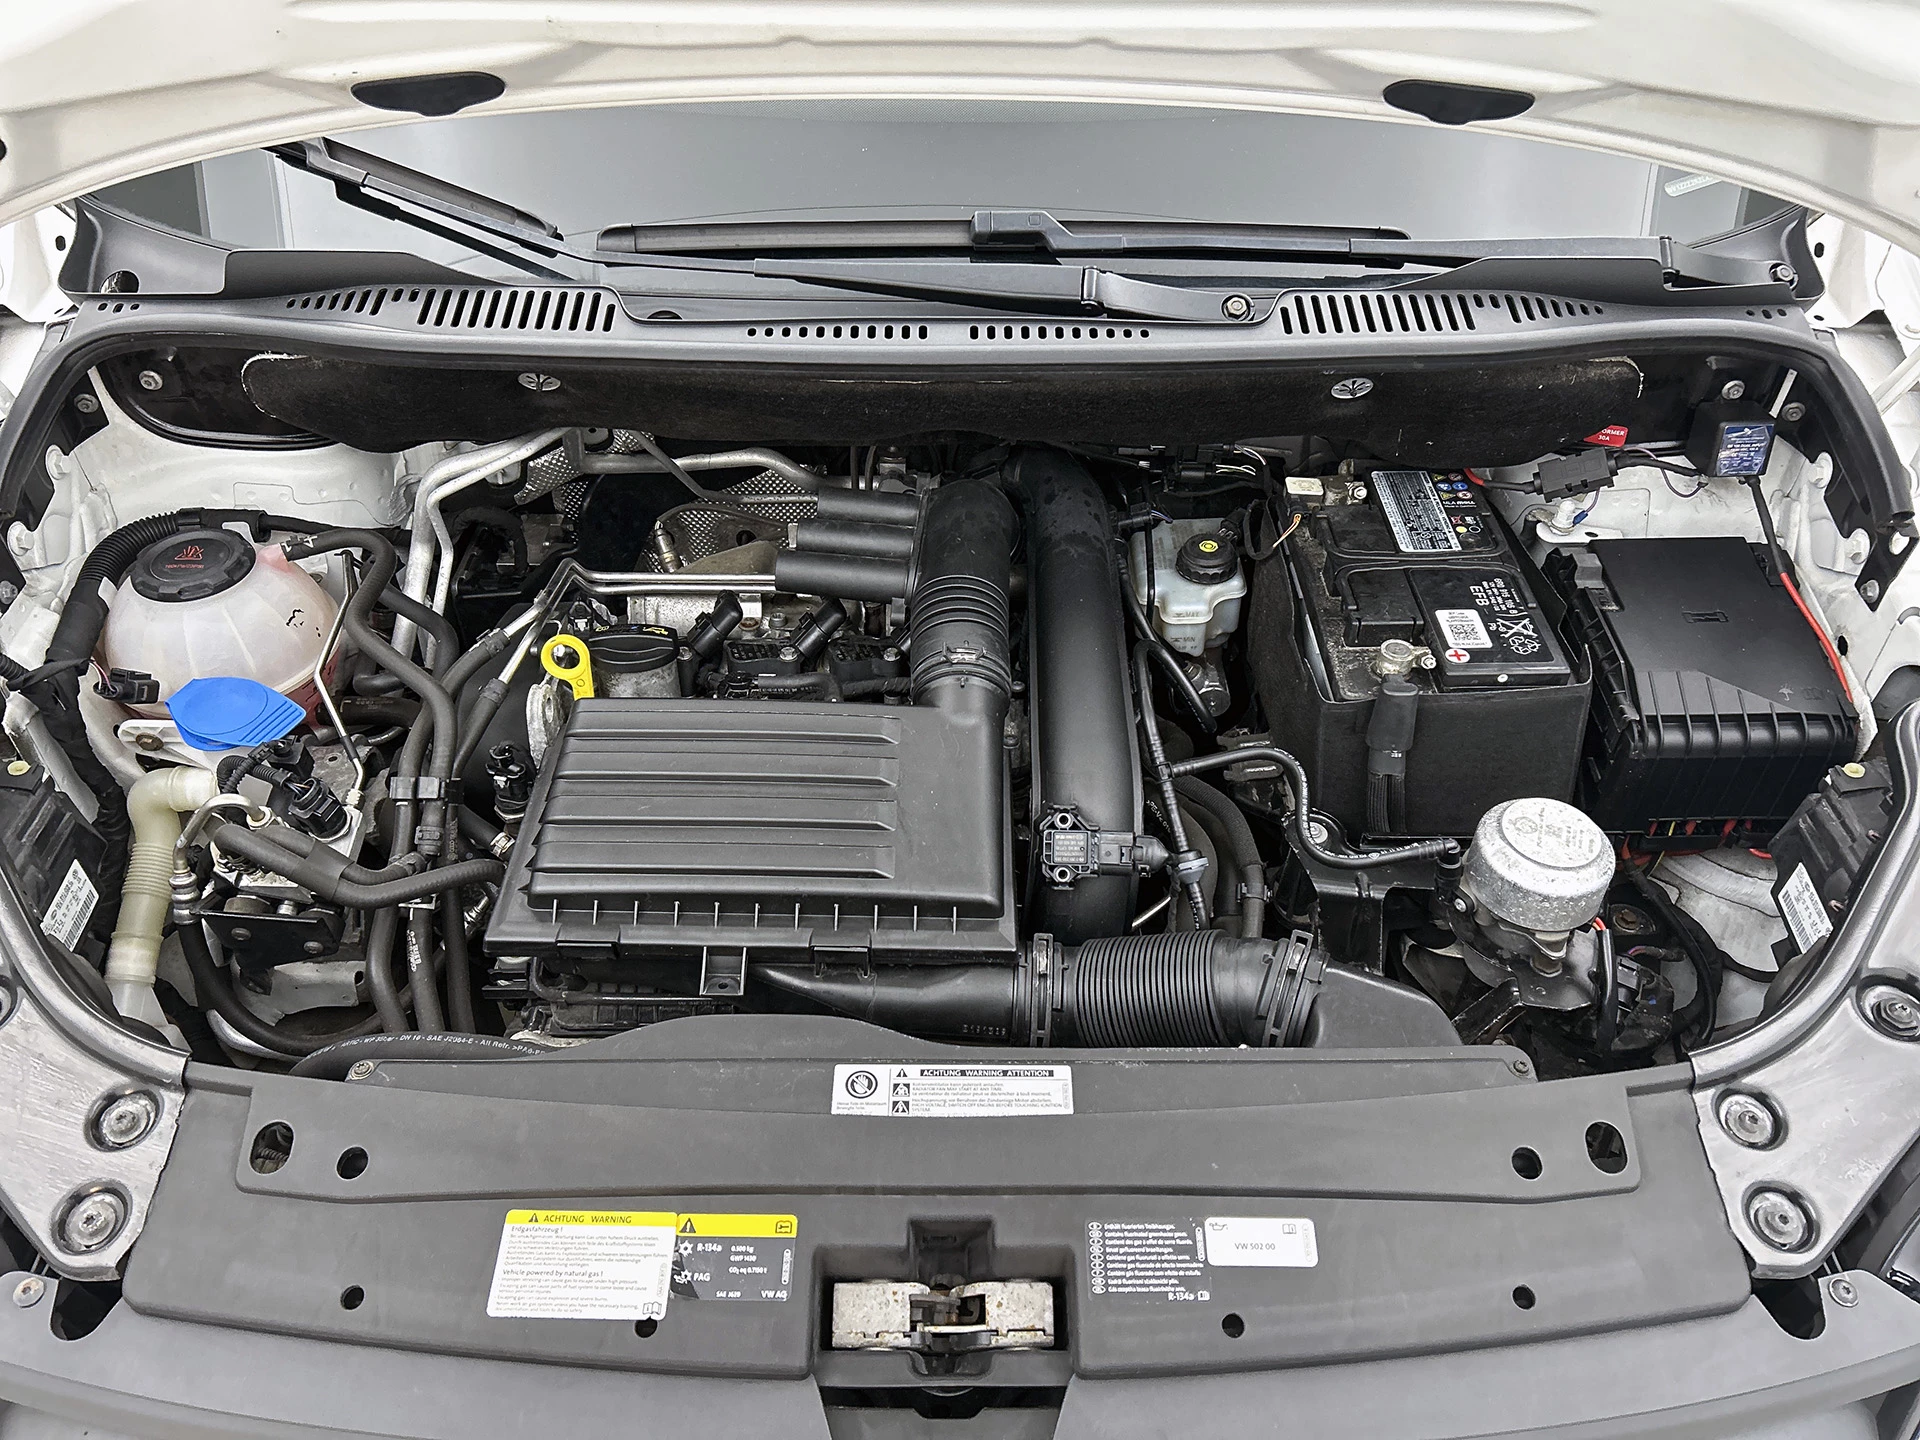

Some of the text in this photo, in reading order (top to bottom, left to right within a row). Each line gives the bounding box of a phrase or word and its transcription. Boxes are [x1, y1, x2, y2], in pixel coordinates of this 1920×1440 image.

[1469, 586, 1490, 606] EFB
[511, 1226, 560, 1234] Erdgasfahrzeug
[696, 1243, 722, 1252] R-134a
[693, 1273, 711, 1281] PAG
[776, 1290, 788, 1298] AG
[1168, 1292, 1195, 1301] R-134a
